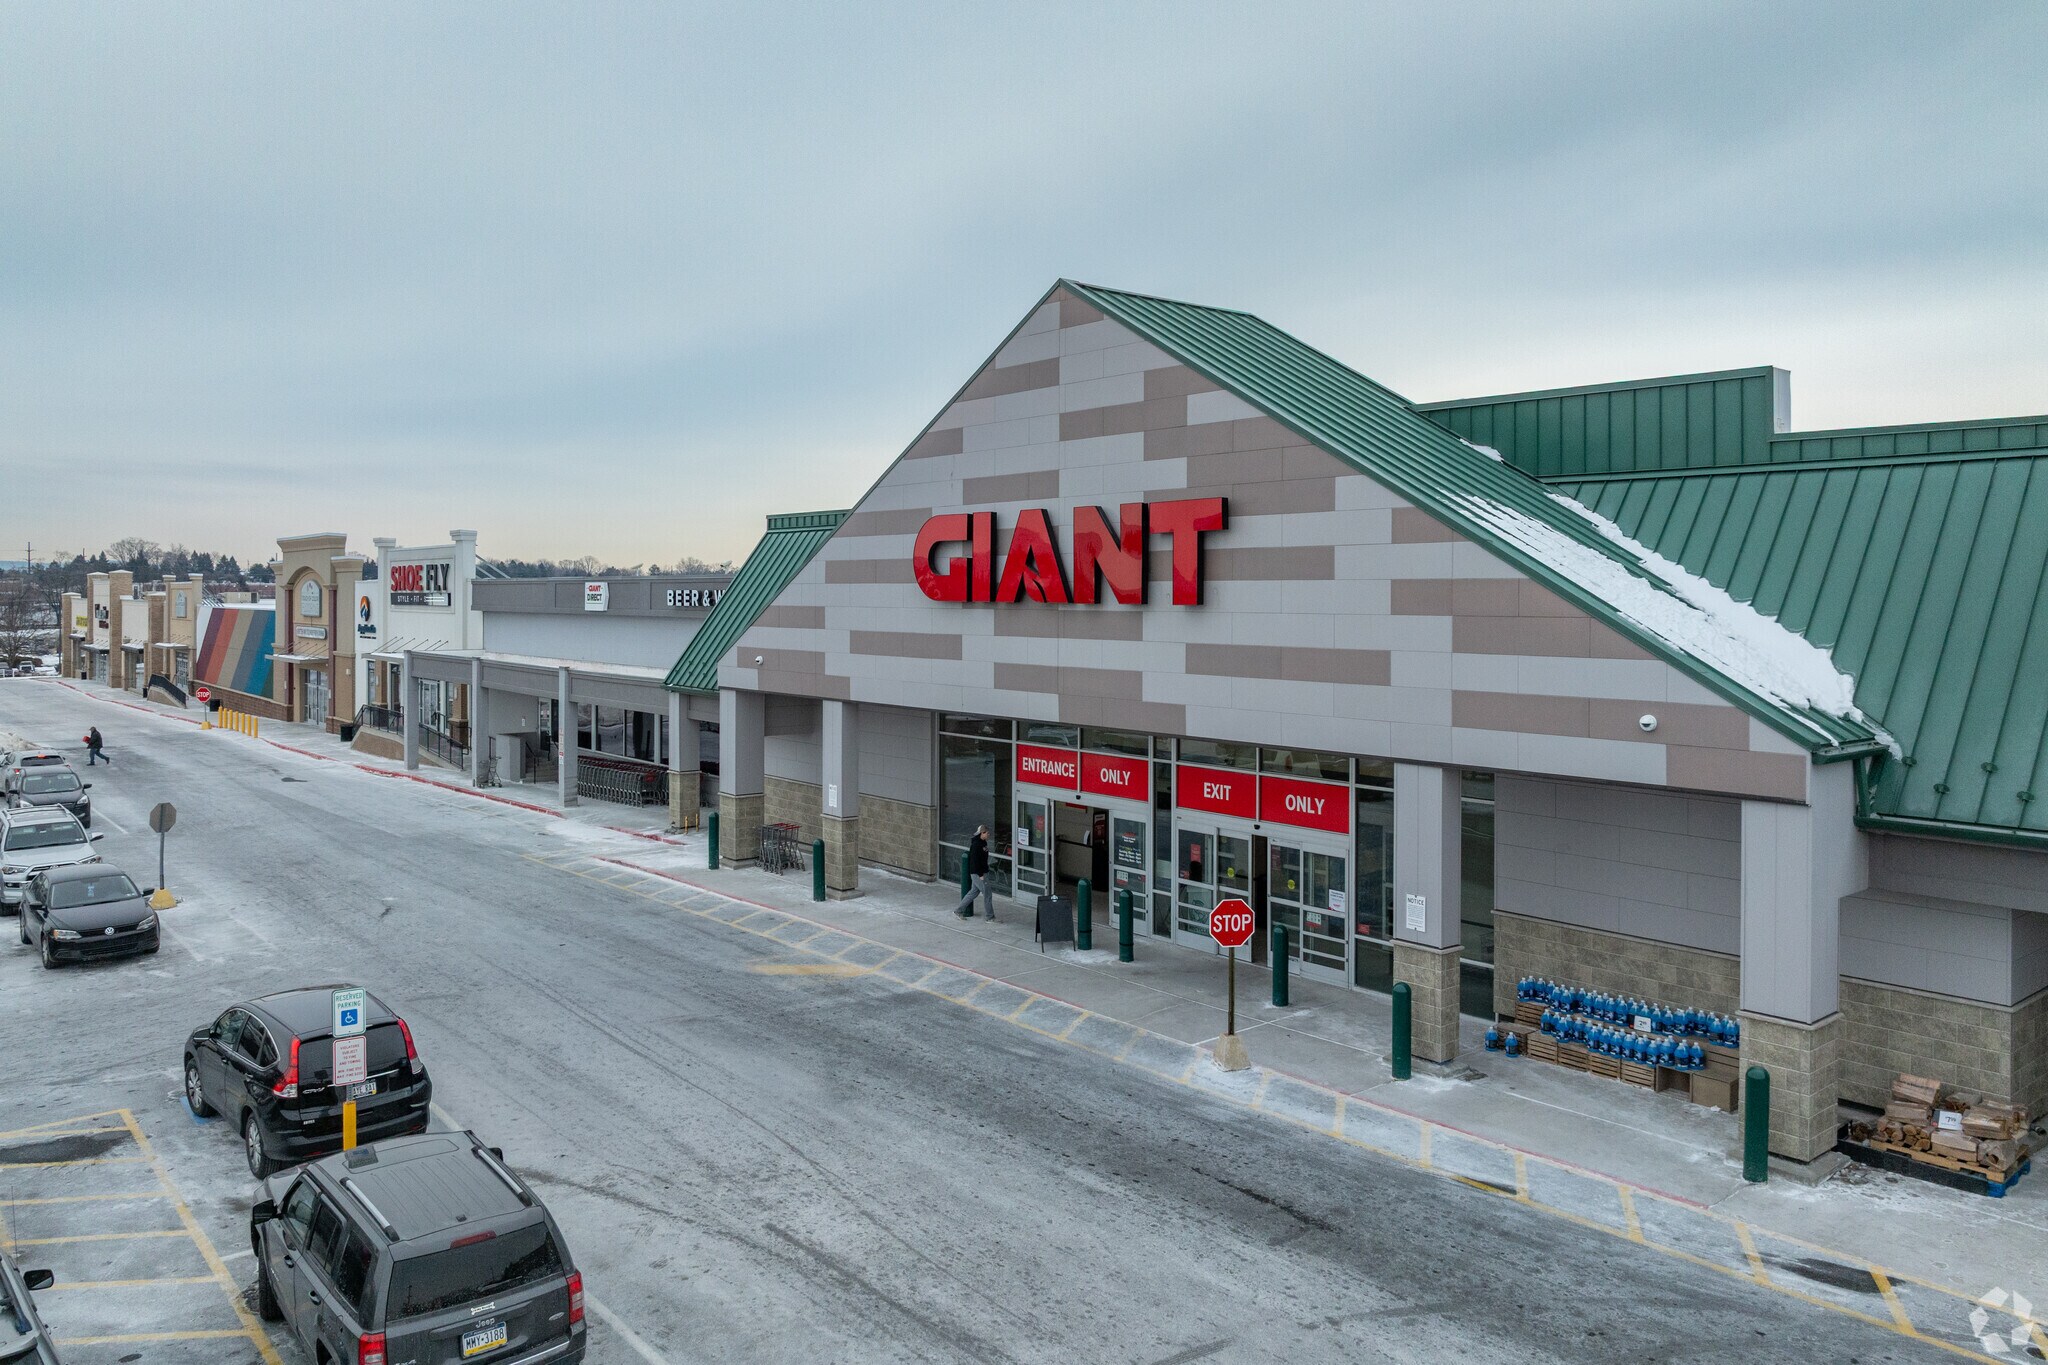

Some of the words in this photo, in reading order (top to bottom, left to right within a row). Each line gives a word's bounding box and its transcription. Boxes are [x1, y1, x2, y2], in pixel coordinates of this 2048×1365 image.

[913, 496, 1229, 606] GIANT
[391, 564, 424, 592] SHOE
[425, 563, 450, 592] FLY
[397, 595, 410, 603] STYLE
[586, 593, 602, 602] DIRECT
[667, 589, 699, 607] BEER
[702, 589, 711, 607] &
[1022, 756, 1075, 778] ENTRANCE
[1100, 767, 1131, 786] ONLY
[1203, 781, 1232, 801] EXIT
[1285, 794, 1325, 815] ONLY
[1407, 897, 1424, 906] NOTICE
[1212, 913, 1252, 933] STOP
[335, 992, 363, 1001] RESERVED
[337, 1000, 361, 1009] PARKING
[475, 1317, 495, 1329] Jeep
